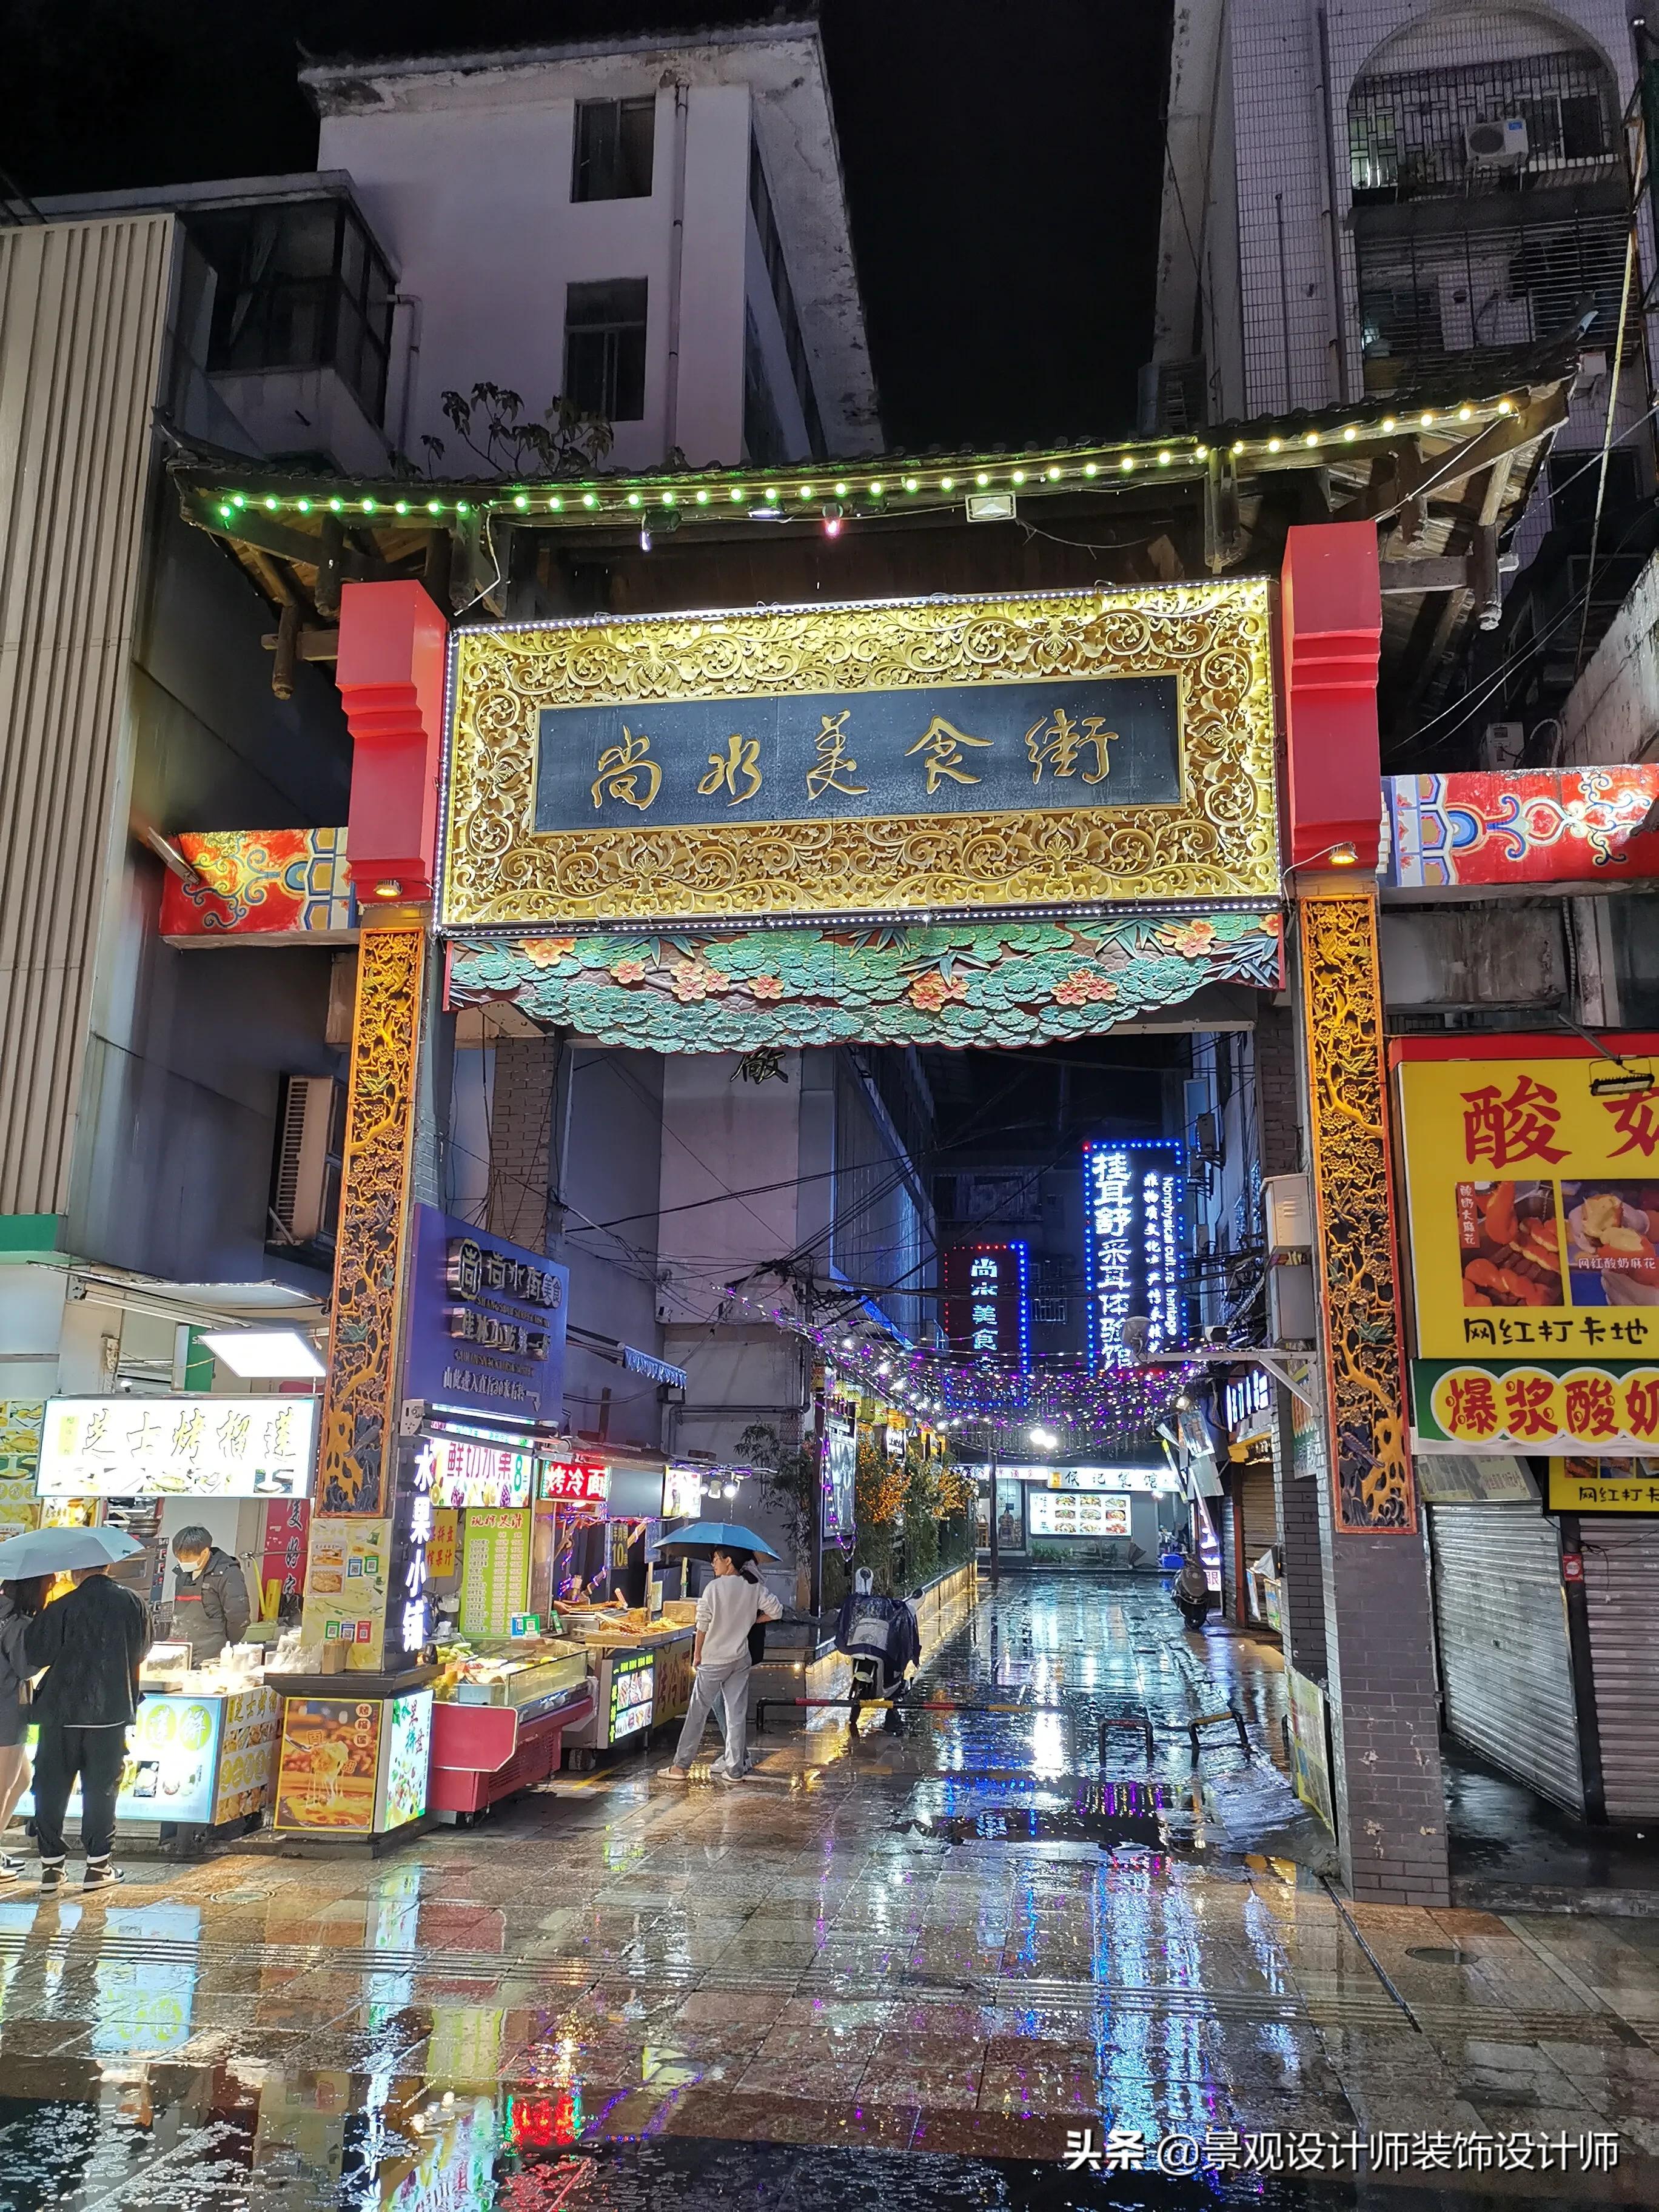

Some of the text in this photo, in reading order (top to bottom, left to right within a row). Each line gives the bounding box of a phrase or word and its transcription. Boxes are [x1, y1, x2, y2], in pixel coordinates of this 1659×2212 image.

[592, 709, 1119, 811] 尚水美食街
[1578, 1257, 1657, 1270] 网红酸奶麻花
[1463, 1317, 1649, 1346] 网红打卡地
[545, 1465, 607, 1497] 烤冷面
[470, 1512, 523, 1529] 现榨果汁
[403, 1444, 435, 1652] 水果小铺
